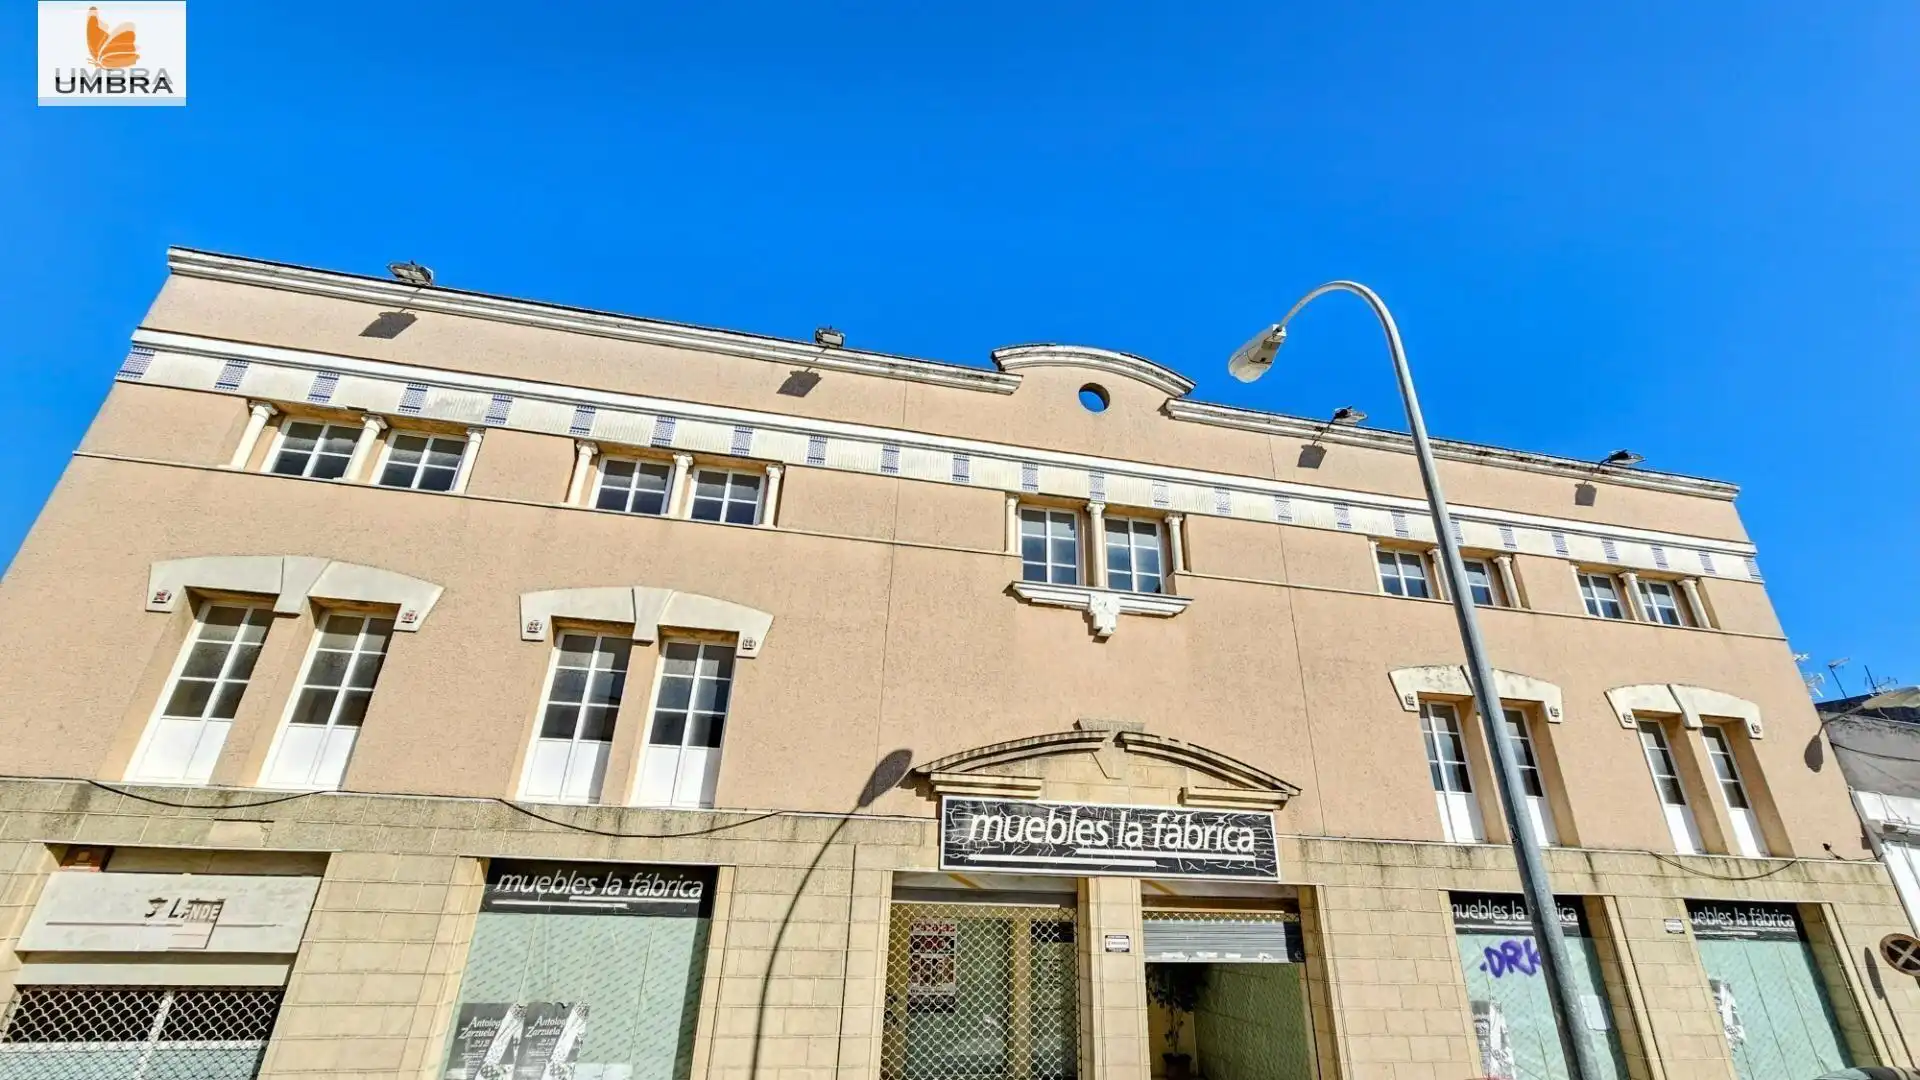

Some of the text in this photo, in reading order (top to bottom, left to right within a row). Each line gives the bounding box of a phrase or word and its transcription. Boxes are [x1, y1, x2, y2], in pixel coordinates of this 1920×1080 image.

[968, 808, 1255, 852] muebles la fábrica
[495, 869, 704, 898] muebles la fábrica
[1512, 900, 1526, 921] la
[1688, 906, 1796, 928] uebles la fábrica
[468, 1016, 501, 1029] Antolog
[534, 1015, 566, 1028] Antolog
